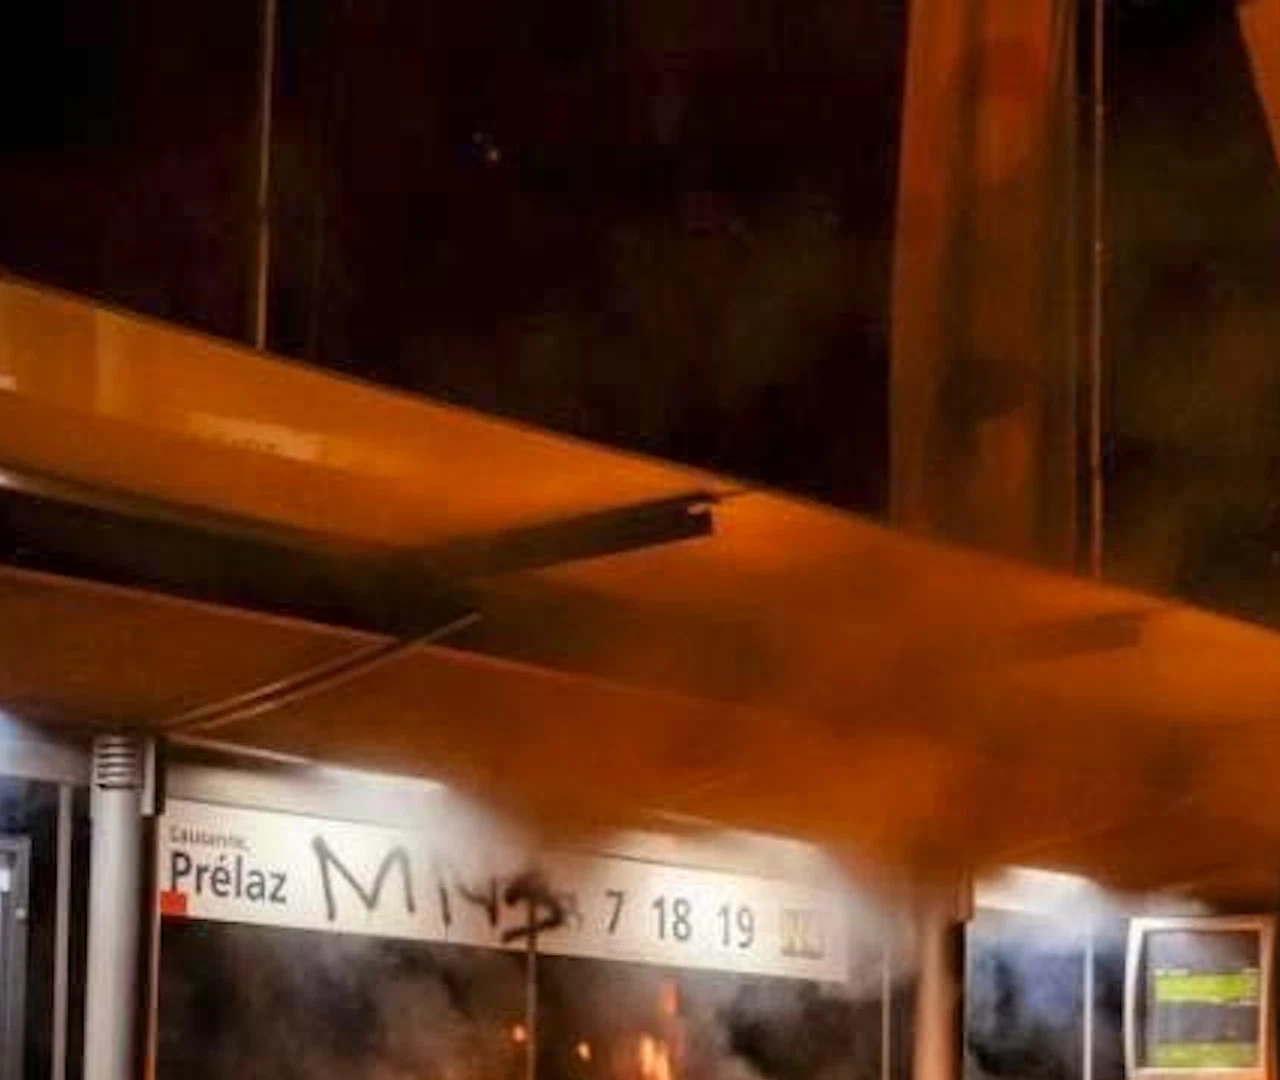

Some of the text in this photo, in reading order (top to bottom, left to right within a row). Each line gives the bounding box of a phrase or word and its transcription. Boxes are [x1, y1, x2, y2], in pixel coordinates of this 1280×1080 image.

[170, 851, 287, 905] Prélaz
[606, 889, 625, 934] 7
[651, 895, 694, 942] 18
[716, 903, 755, 950] 19
